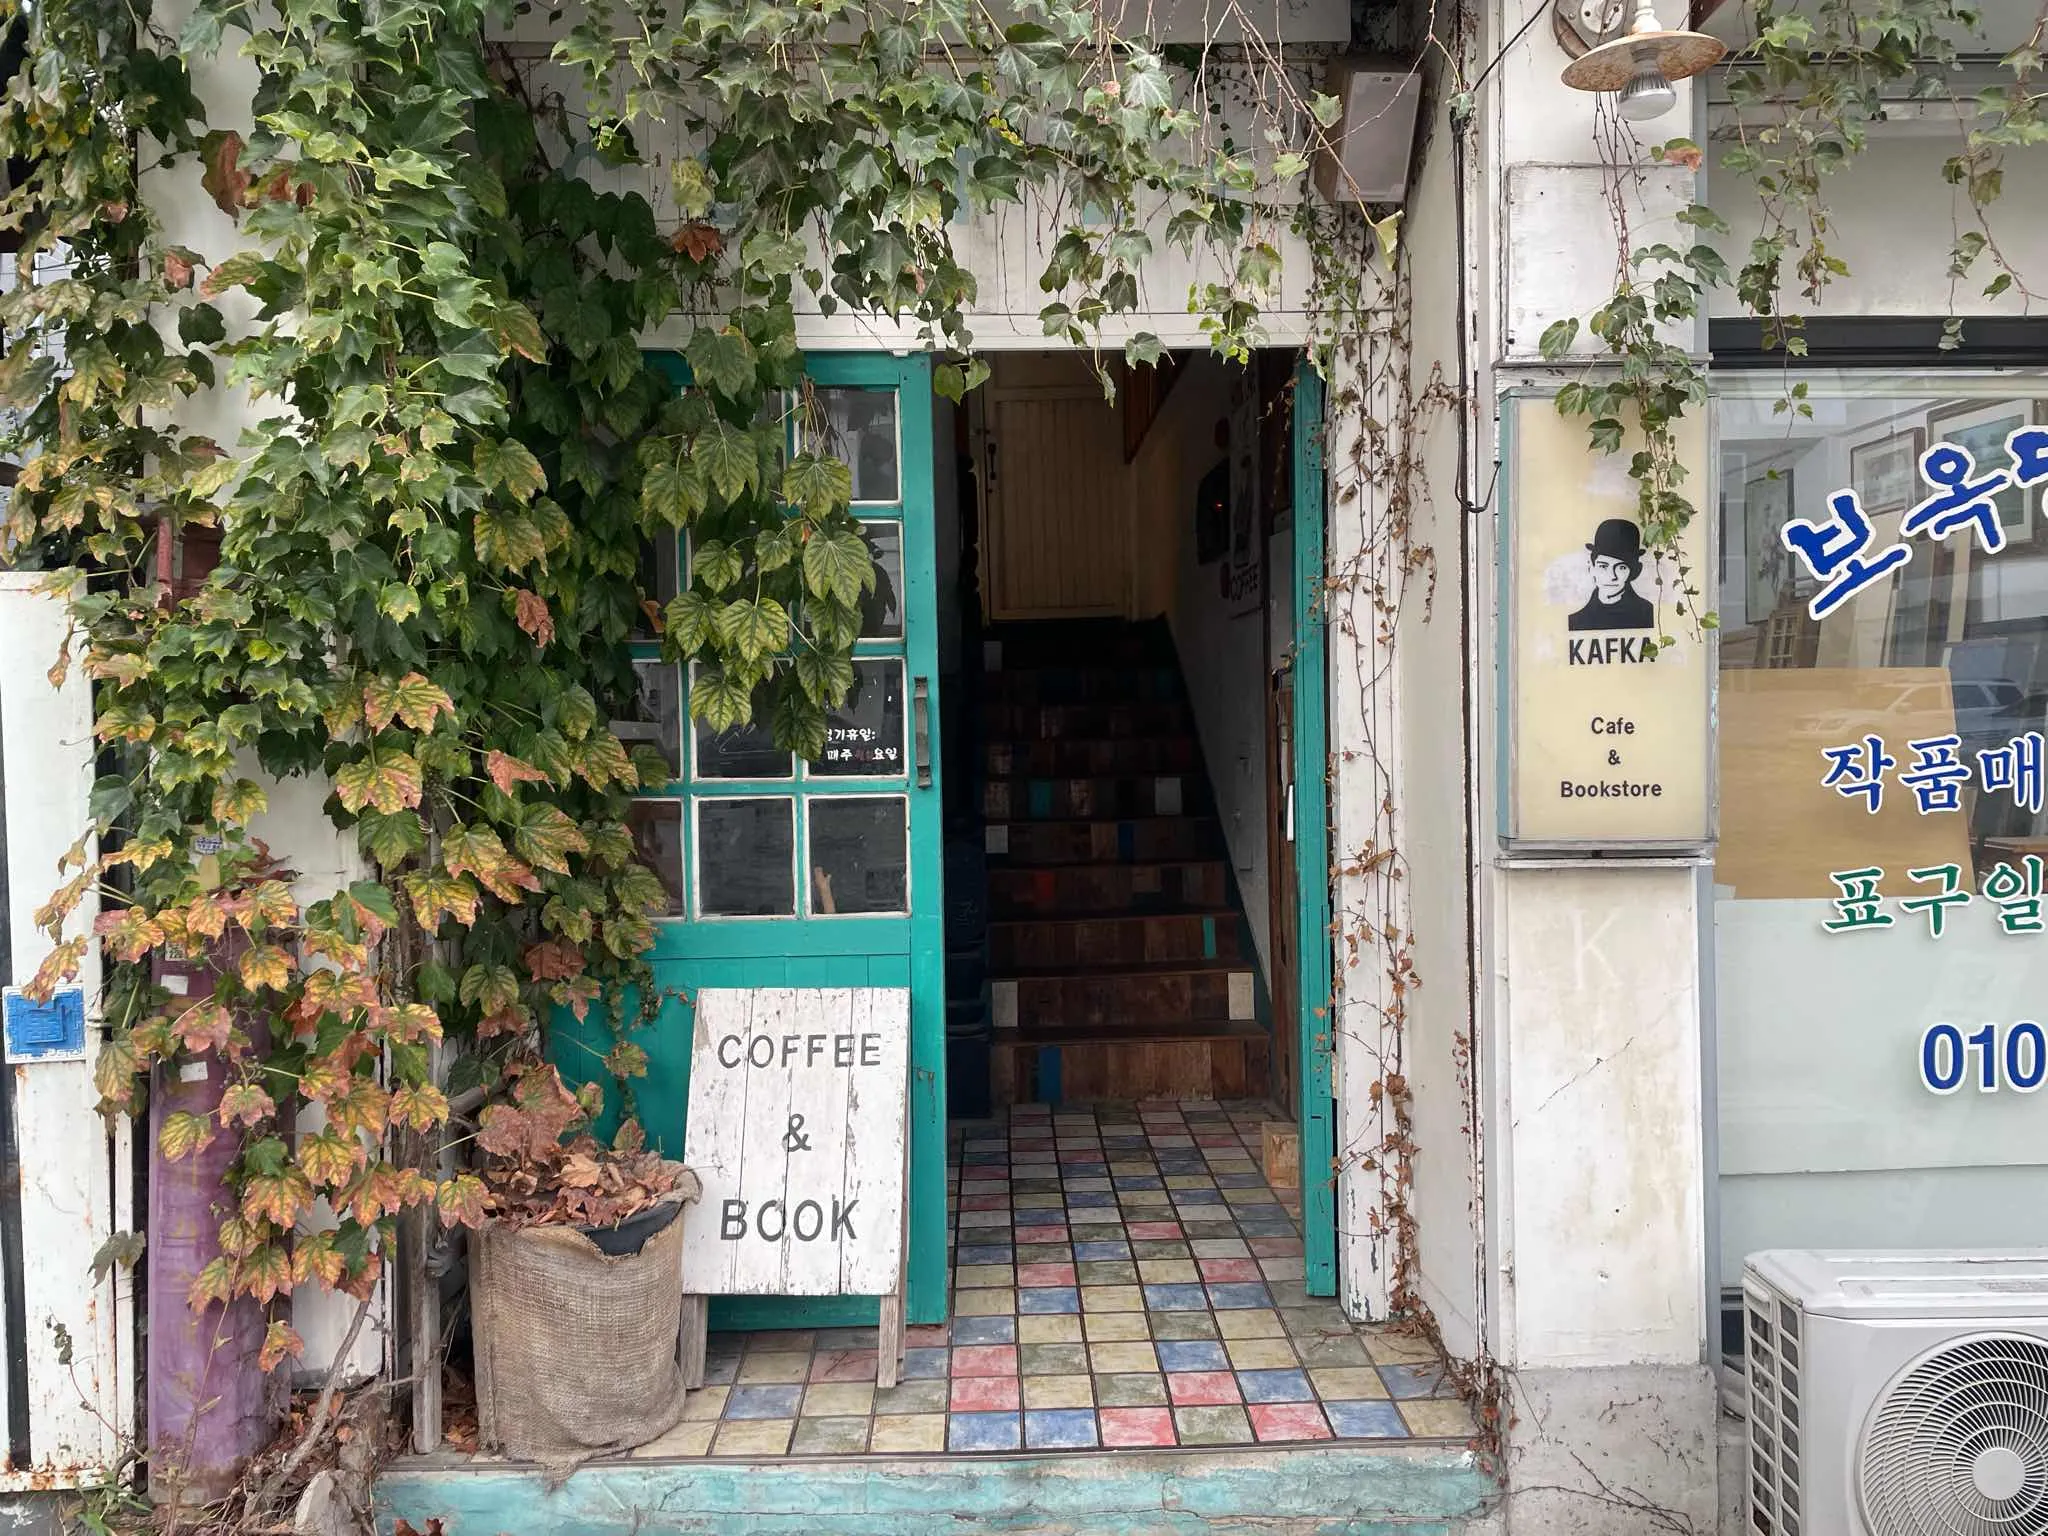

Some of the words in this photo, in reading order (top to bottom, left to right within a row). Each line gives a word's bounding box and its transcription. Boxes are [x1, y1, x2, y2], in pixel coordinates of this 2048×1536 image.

[1568, 636, 1657, 666] KAFKA
[1591, 716, 1636, 736] Cafe
[827, 747, 854, 762] 매주
[1607, 748, 1622, 766] &
[1560, 779, 1663, 799] Bookstore
[1826, 857, 2042, 938] 표구일
[717, 1033, 882, 1069] COFFEE
[1921, 1021, 2048, 1092] 010
[783, 1112, 812, 1153] &
[720, 1197, 861, 1242] BOOK
